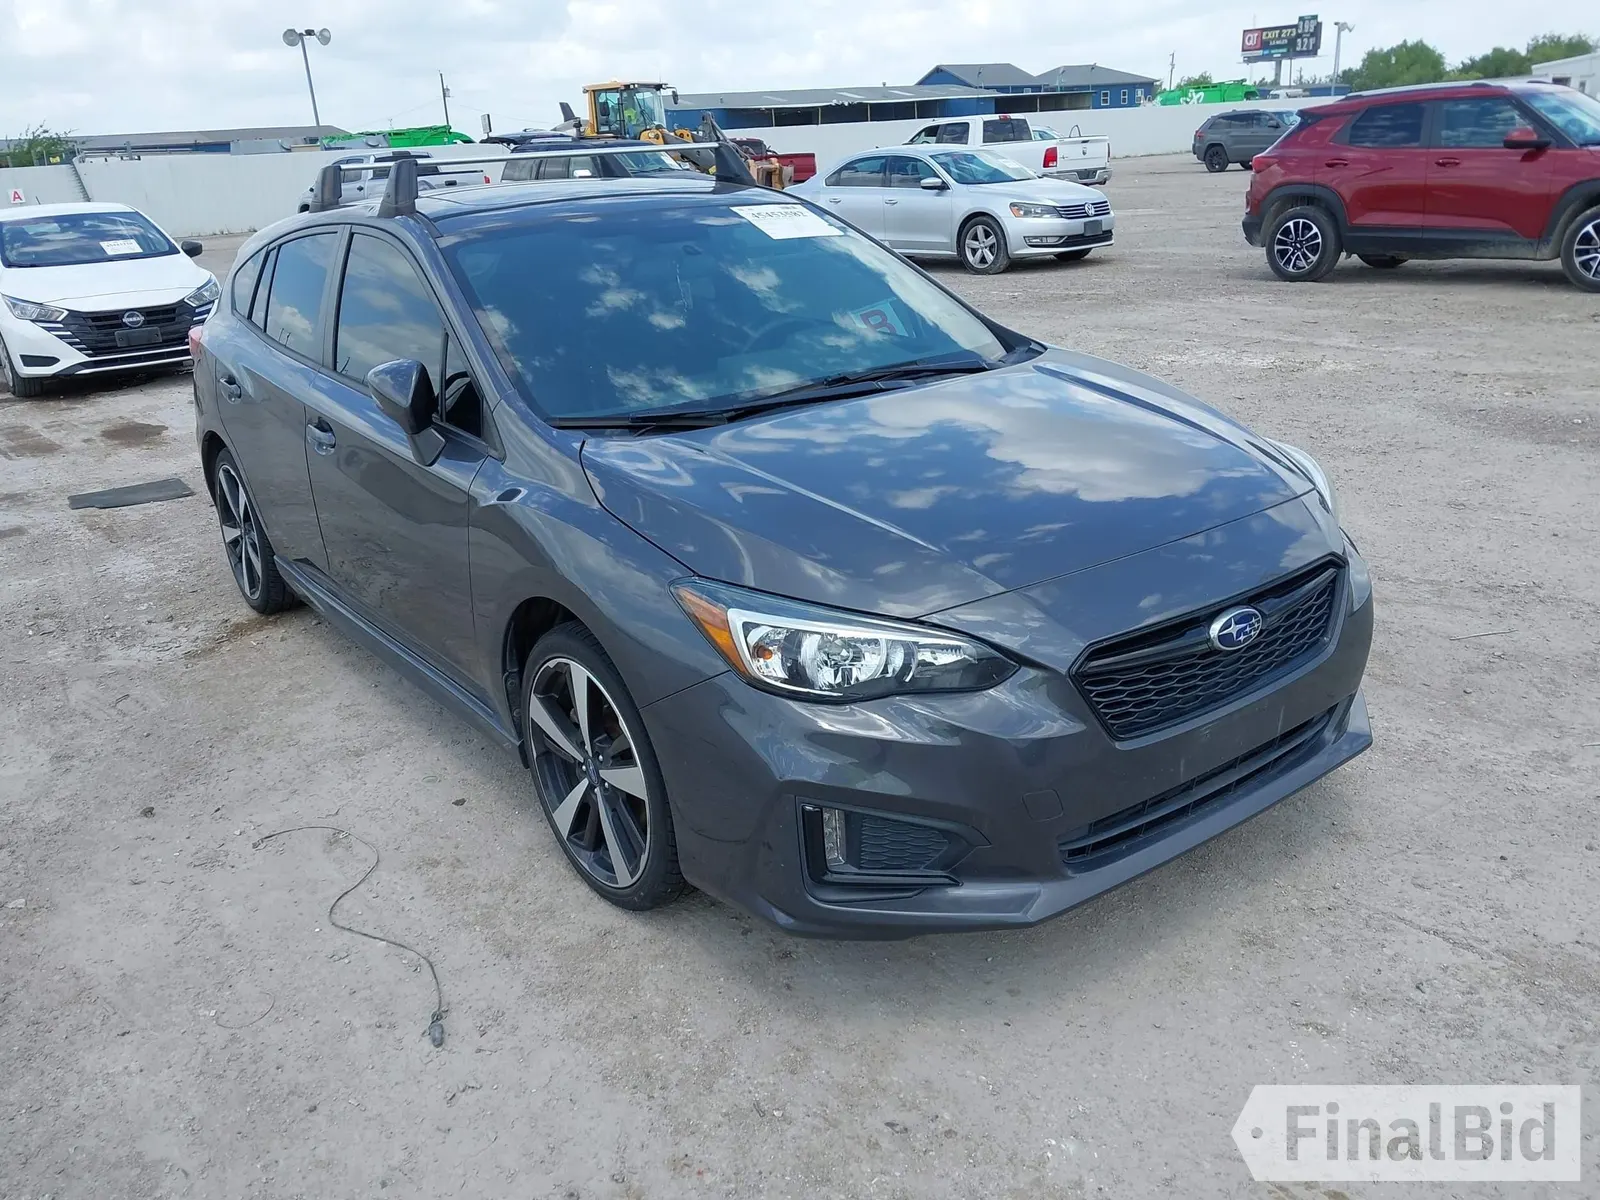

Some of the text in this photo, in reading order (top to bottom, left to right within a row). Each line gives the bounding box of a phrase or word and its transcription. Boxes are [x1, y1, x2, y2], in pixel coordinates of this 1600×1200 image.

[1245, 33, 1258, 46] QT
[1262, 30, 1280, 39] EXIT
[1281, 28, 1296, 38] 273
[12, 190, 23, 202] A
[859, 310, 897, 336] B
